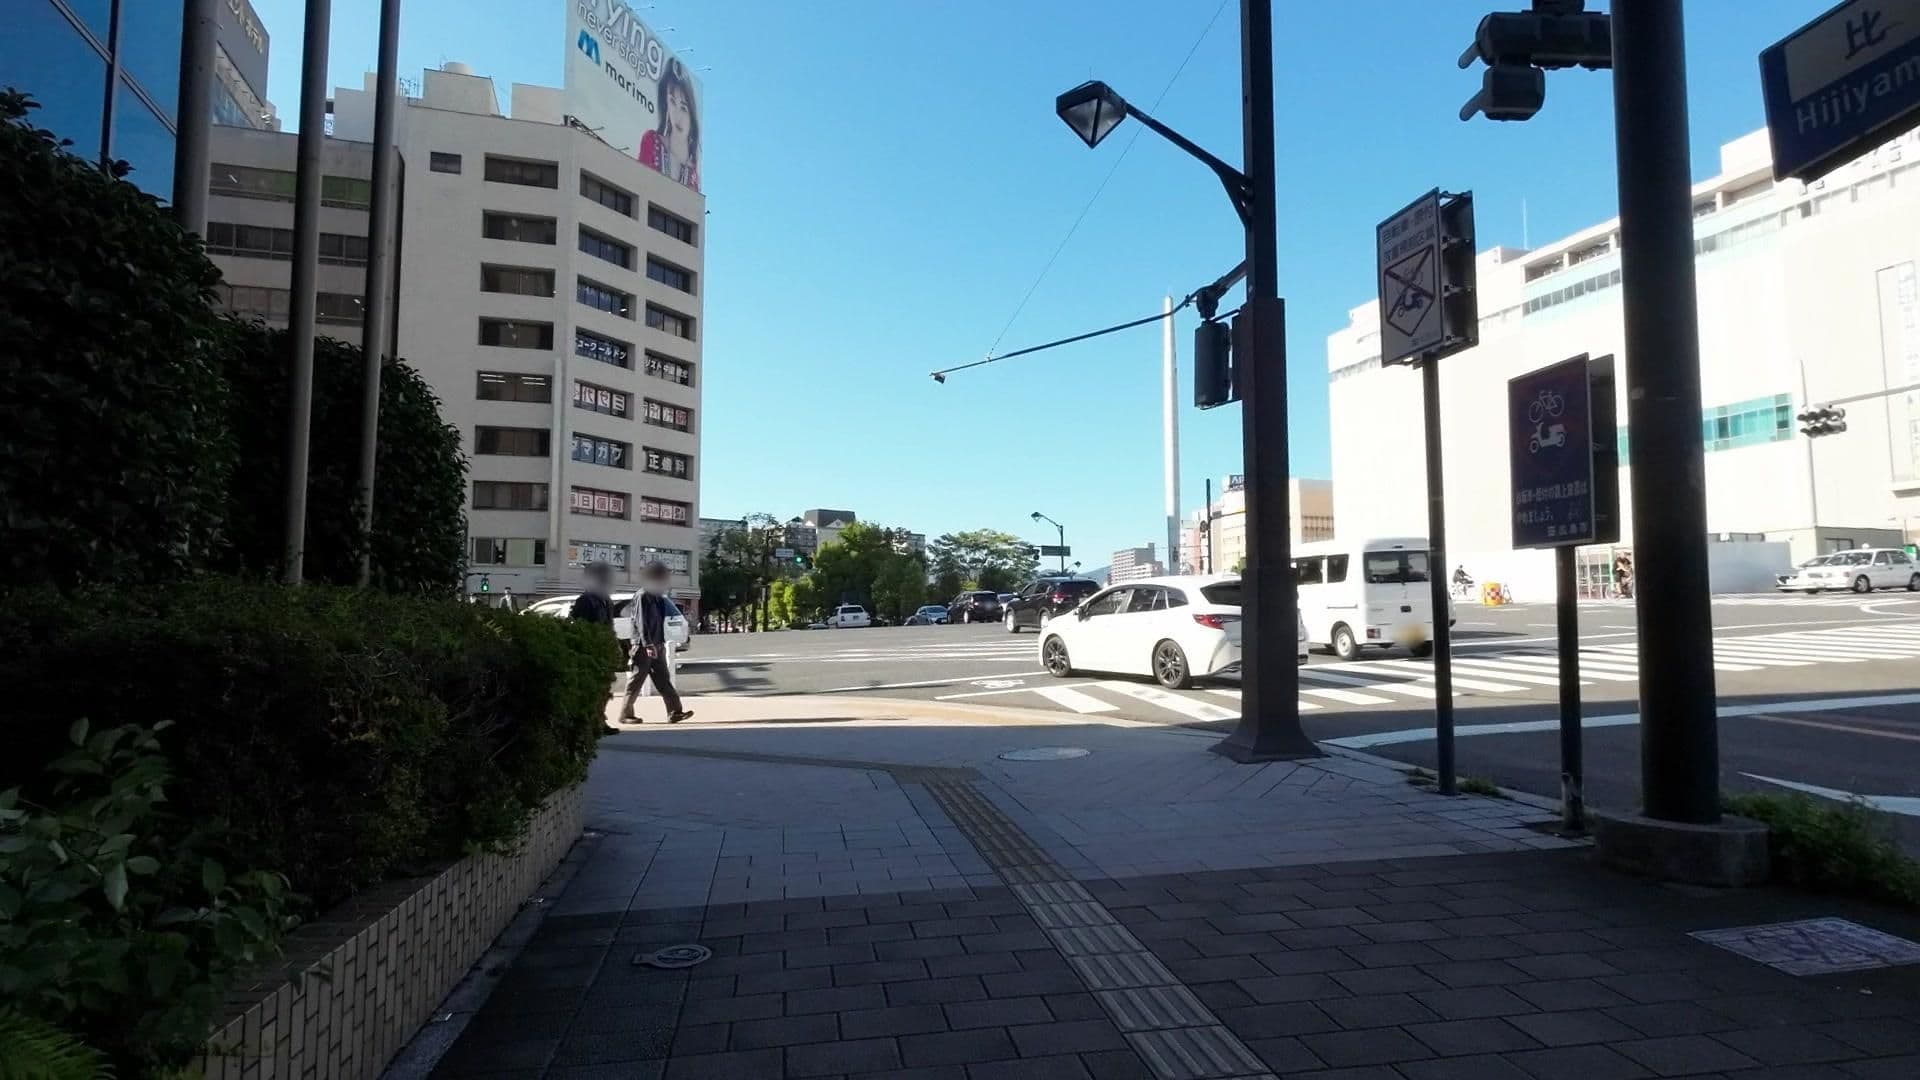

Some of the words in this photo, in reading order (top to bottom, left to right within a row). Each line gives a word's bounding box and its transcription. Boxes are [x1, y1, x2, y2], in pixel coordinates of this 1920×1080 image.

[578, 3, 617, 48] never
[605, 61, 655, 114] marimo
[575, 338, 627, 360] ューワールドツ
[583, 548, 623, 564] 佐々木
